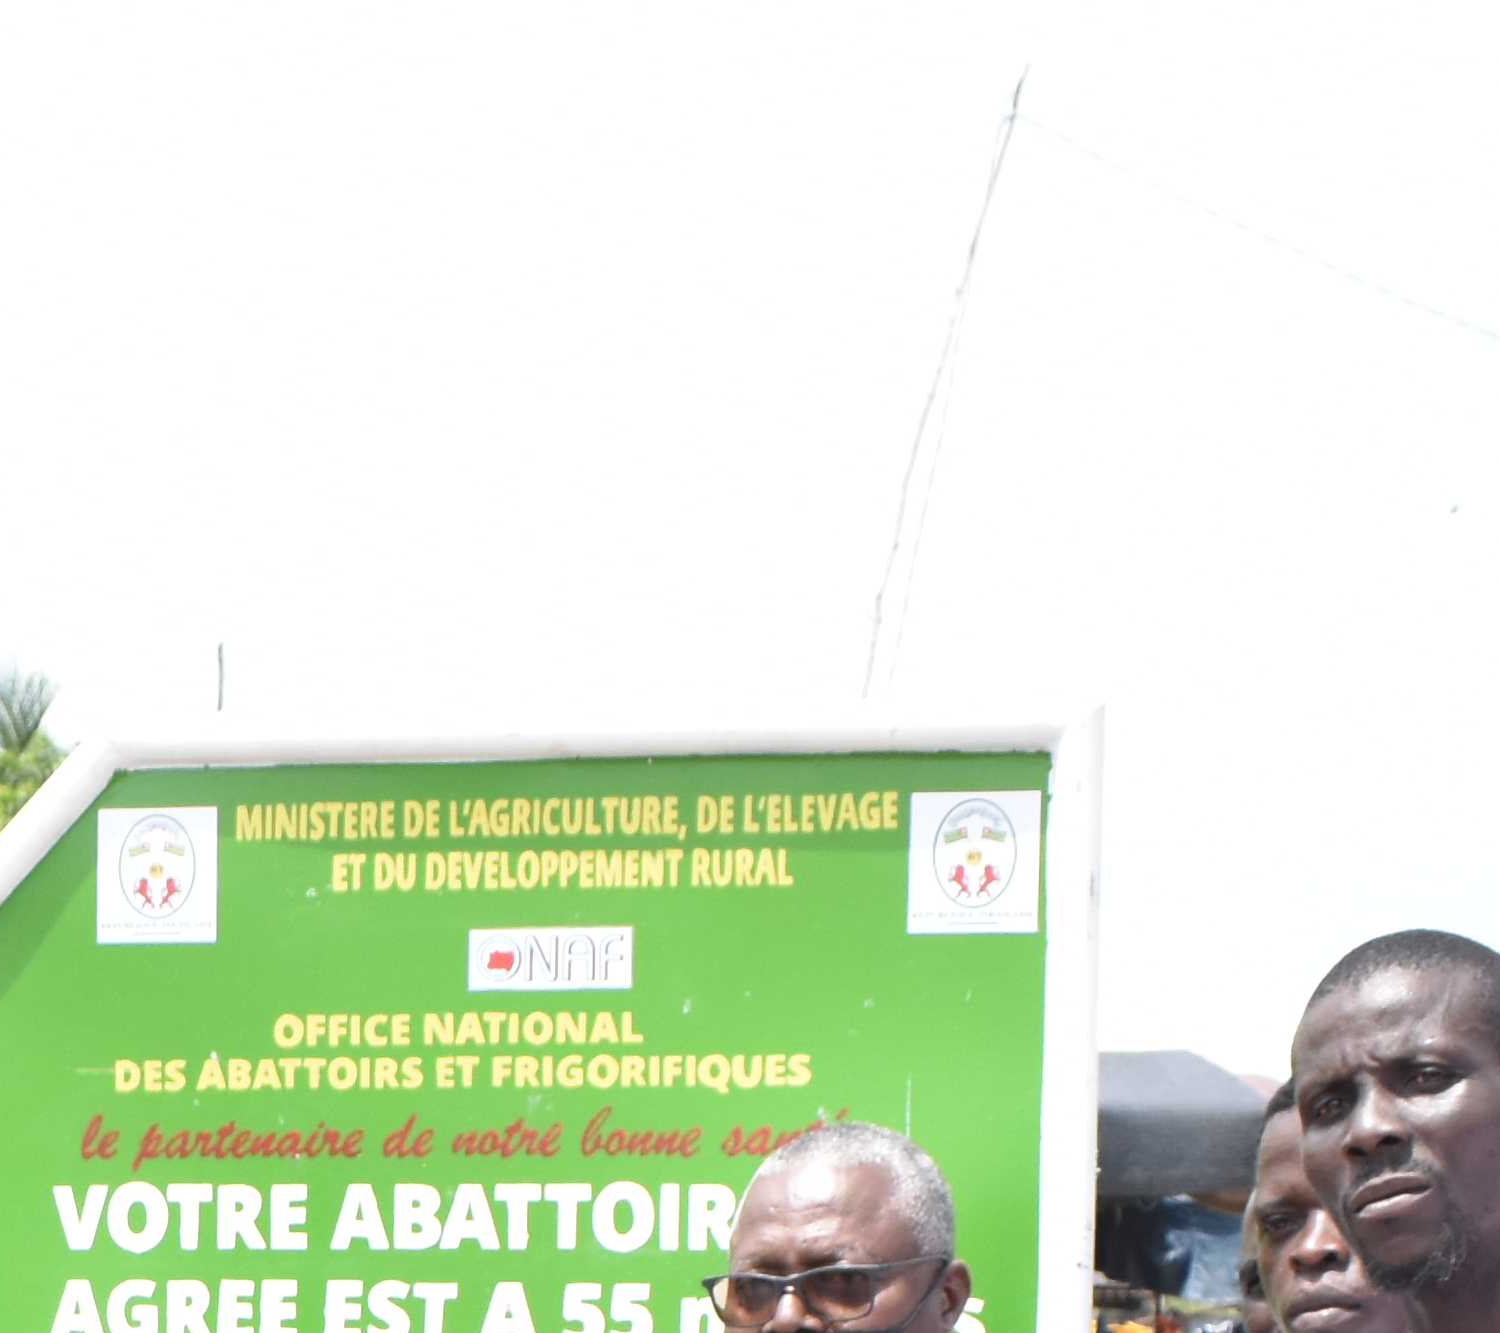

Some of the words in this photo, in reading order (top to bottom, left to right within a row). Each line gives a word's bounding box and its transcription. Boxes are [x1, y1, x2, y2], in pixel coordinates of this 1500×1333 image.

[236, 803, 394, 841] MINISTERE
[404, 800, 439, 838] DE
[698, 795, 734, 832] DE
[744, 791, 898, 832] L'ELEVAGE
[332, 853, 366, 892] ET
[375, 852, 416, 891] DU
[426, 849, 683, 891] DEVELOPPEMENT
[692, 849, 793, 887] RURAL
[476, 933, 624, 983] ONAF
[274, 1013, 411, 1047] OFFICE
[424, 1010, 643, 1046] NATIONAL
[115, 1059, 186, 1092] DES
[197, 1057, 424, 1091] ABATTOIRS
[436, 1056, 479, 1088] ET
[492, 1053, 812, 1093] FRIGORIFIQUES
[82, 1112, 120, 1160] le
[132, 1118, 365, 1172] partenaire
[382, 1112, 434, 1159] de
[451, 1113, 563, 1158] notre
[581, 1107, 702, 1158] bonne
[53, 1181, 307, 1253] VOTRE
